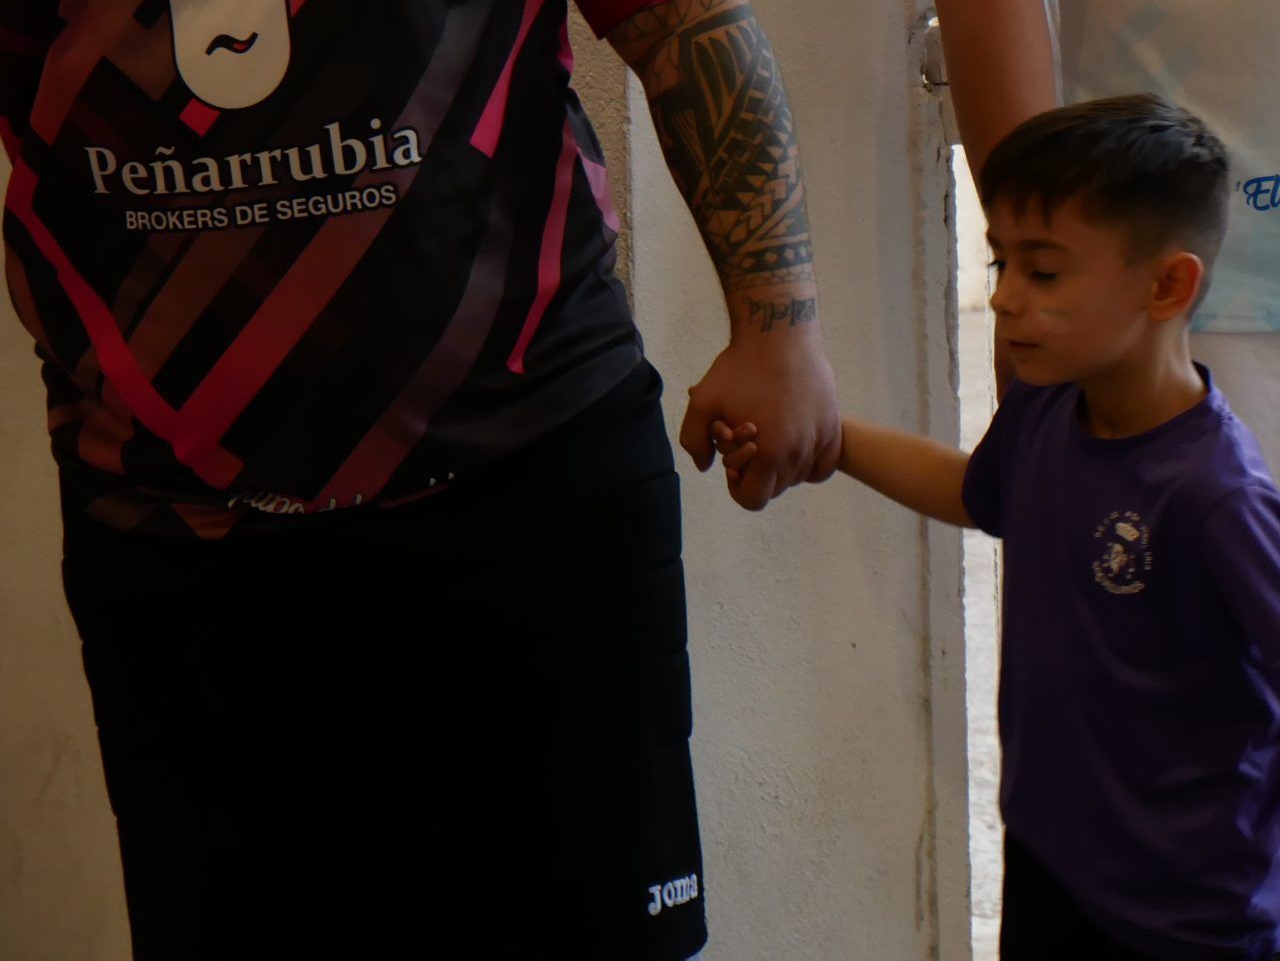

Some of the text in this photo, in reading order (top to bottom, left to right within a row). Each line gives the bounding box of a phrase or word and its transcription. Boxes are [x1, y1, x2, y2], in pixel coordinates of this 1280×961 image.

[84, 117, 424, 195] Peñarrubia
[125, 185, 397, 230] BROKERS DE SEGUROS
